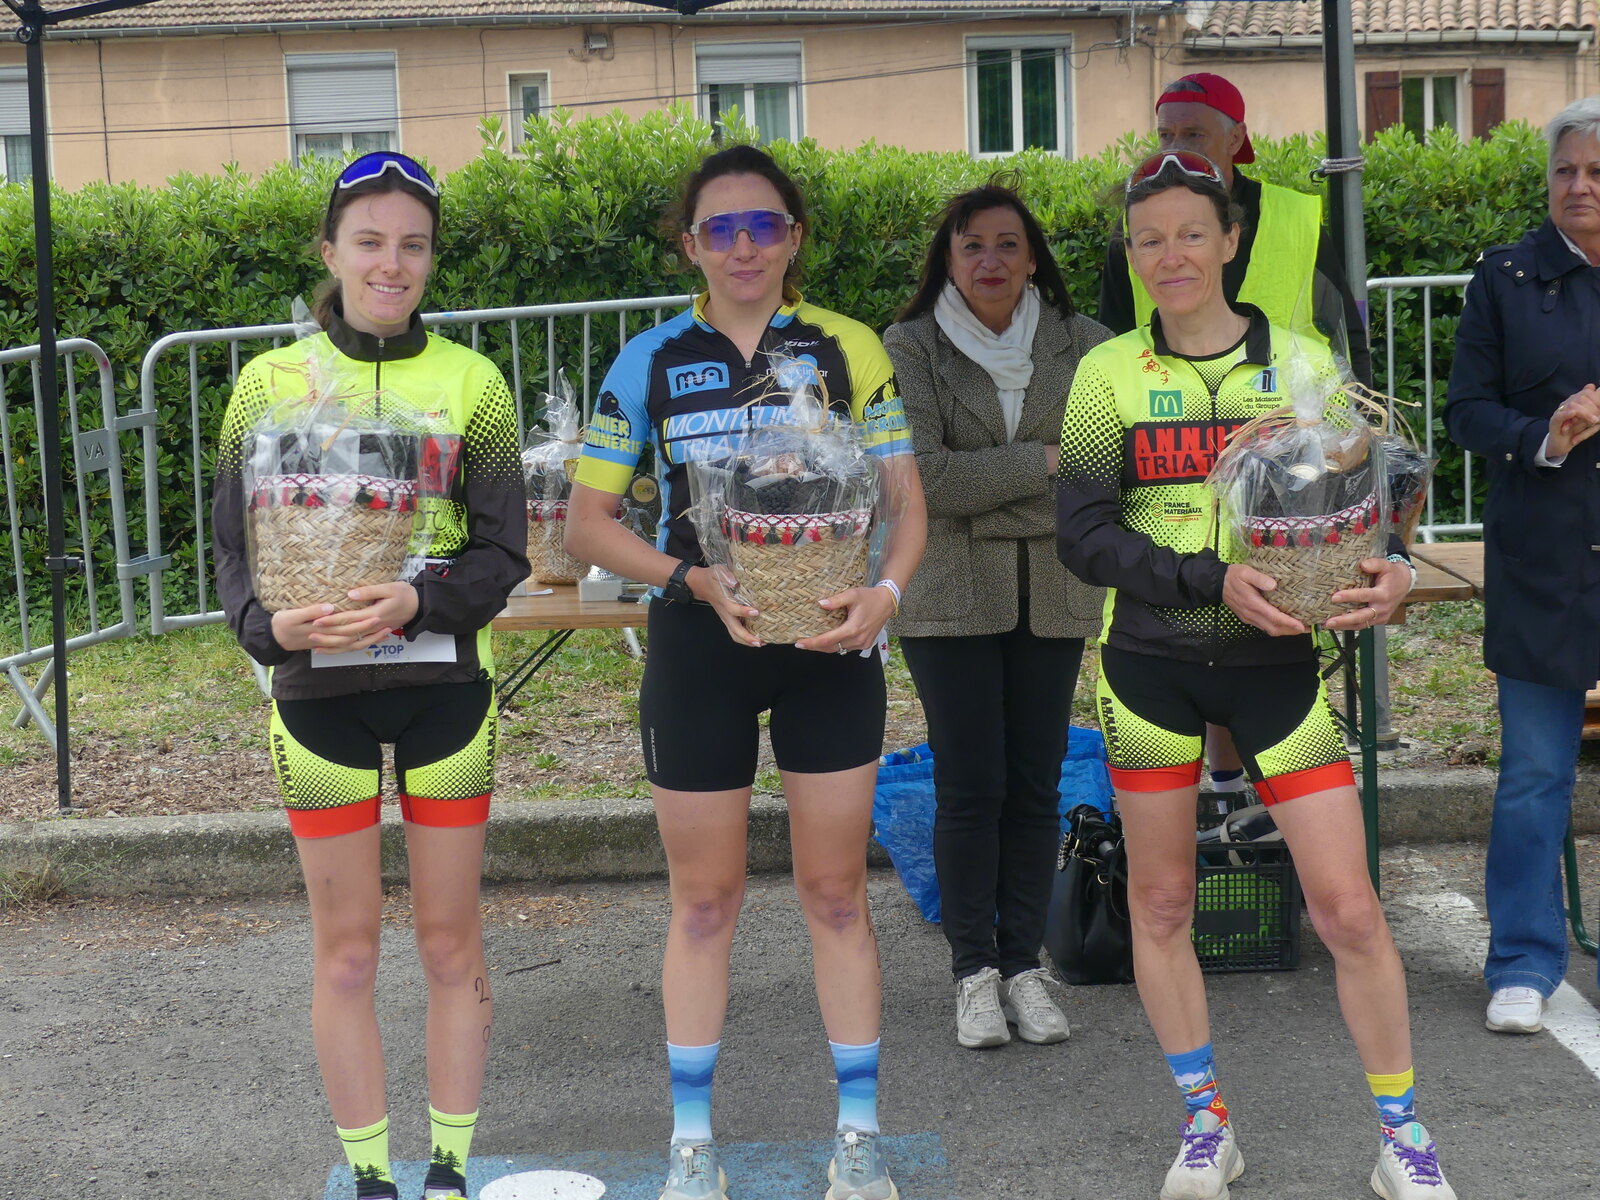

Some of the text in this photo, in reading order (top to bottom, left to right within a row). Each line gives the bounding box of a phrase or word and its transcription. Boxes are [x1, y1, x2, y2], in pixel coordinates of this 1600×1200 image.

[84, 442, 105, 460] VA
[1138, 453, 1217, 476] TRIAT
[381, 645, 404, 654] TOP
